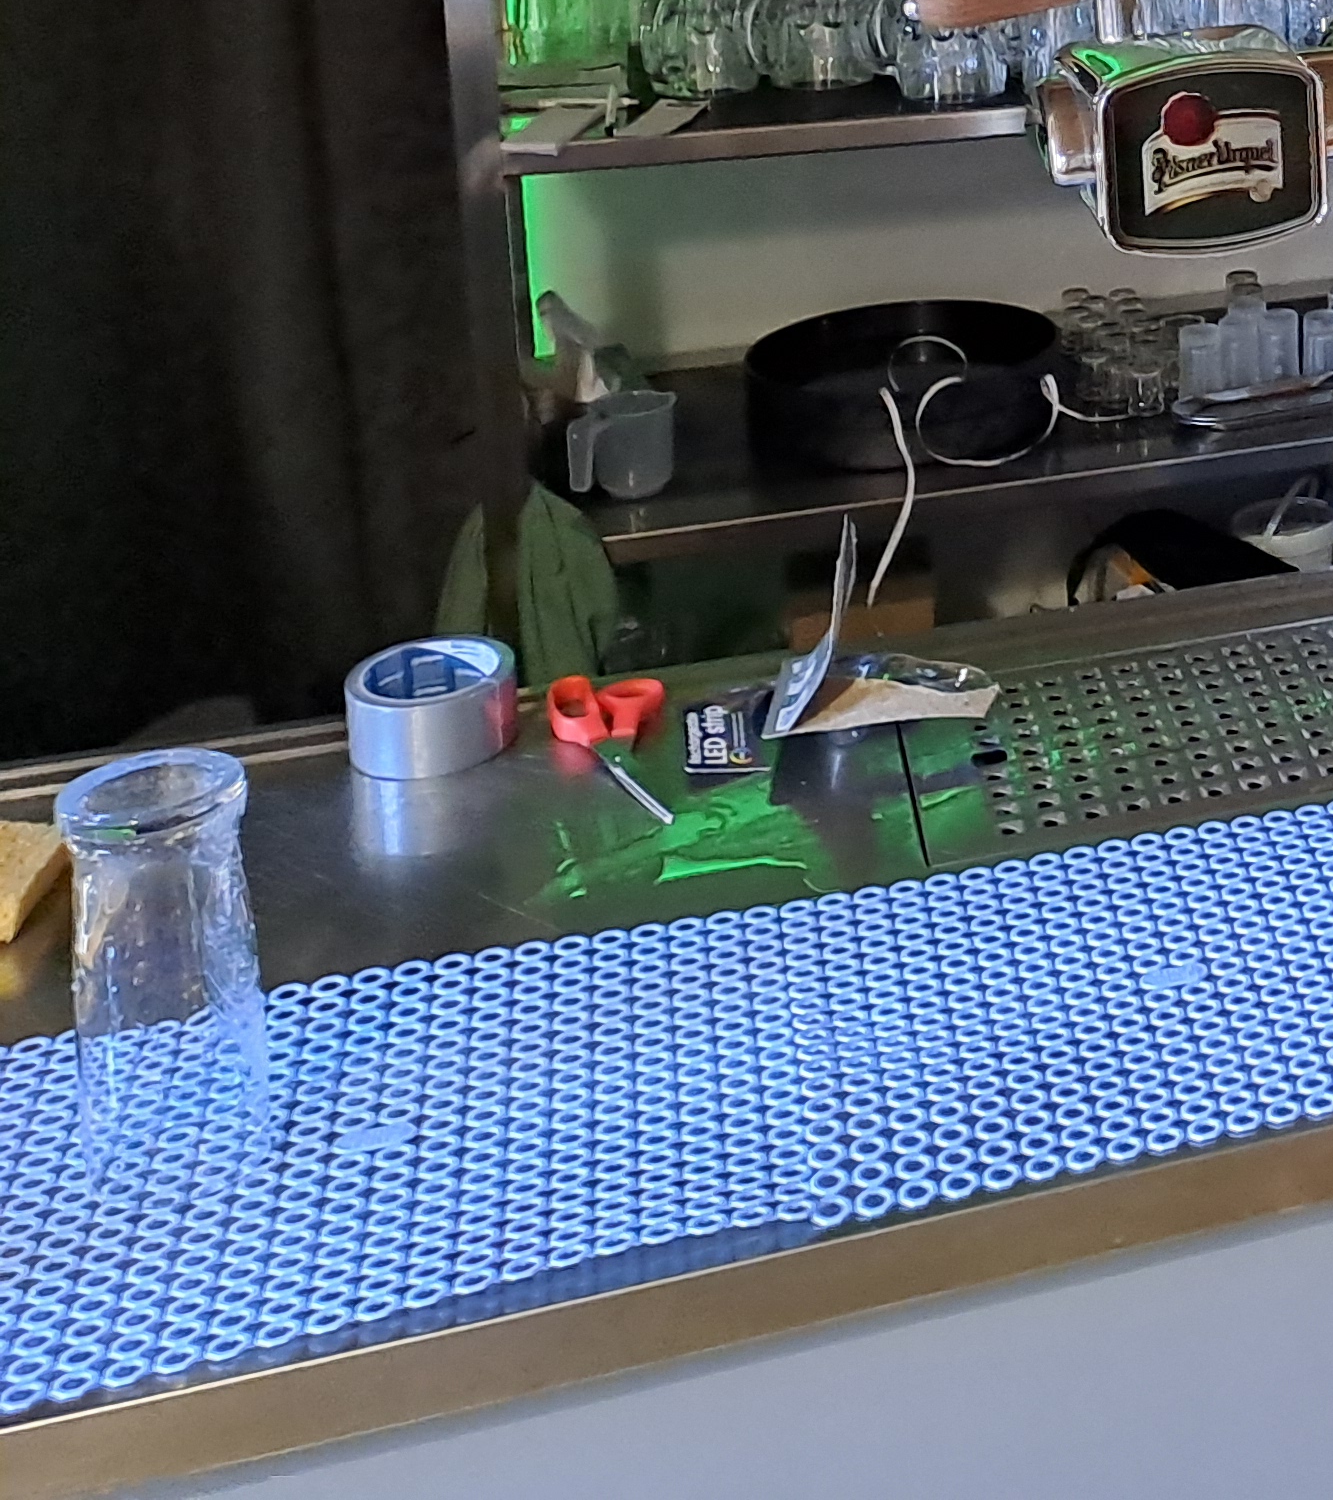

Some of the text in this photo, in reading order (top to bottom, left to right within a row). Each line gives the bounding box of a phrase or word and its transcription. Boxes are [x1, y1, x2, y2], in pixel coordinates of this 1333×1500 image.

[1151, 147, 1216, 196] Pilsner
[700, 704, 729, 765] LED strip
